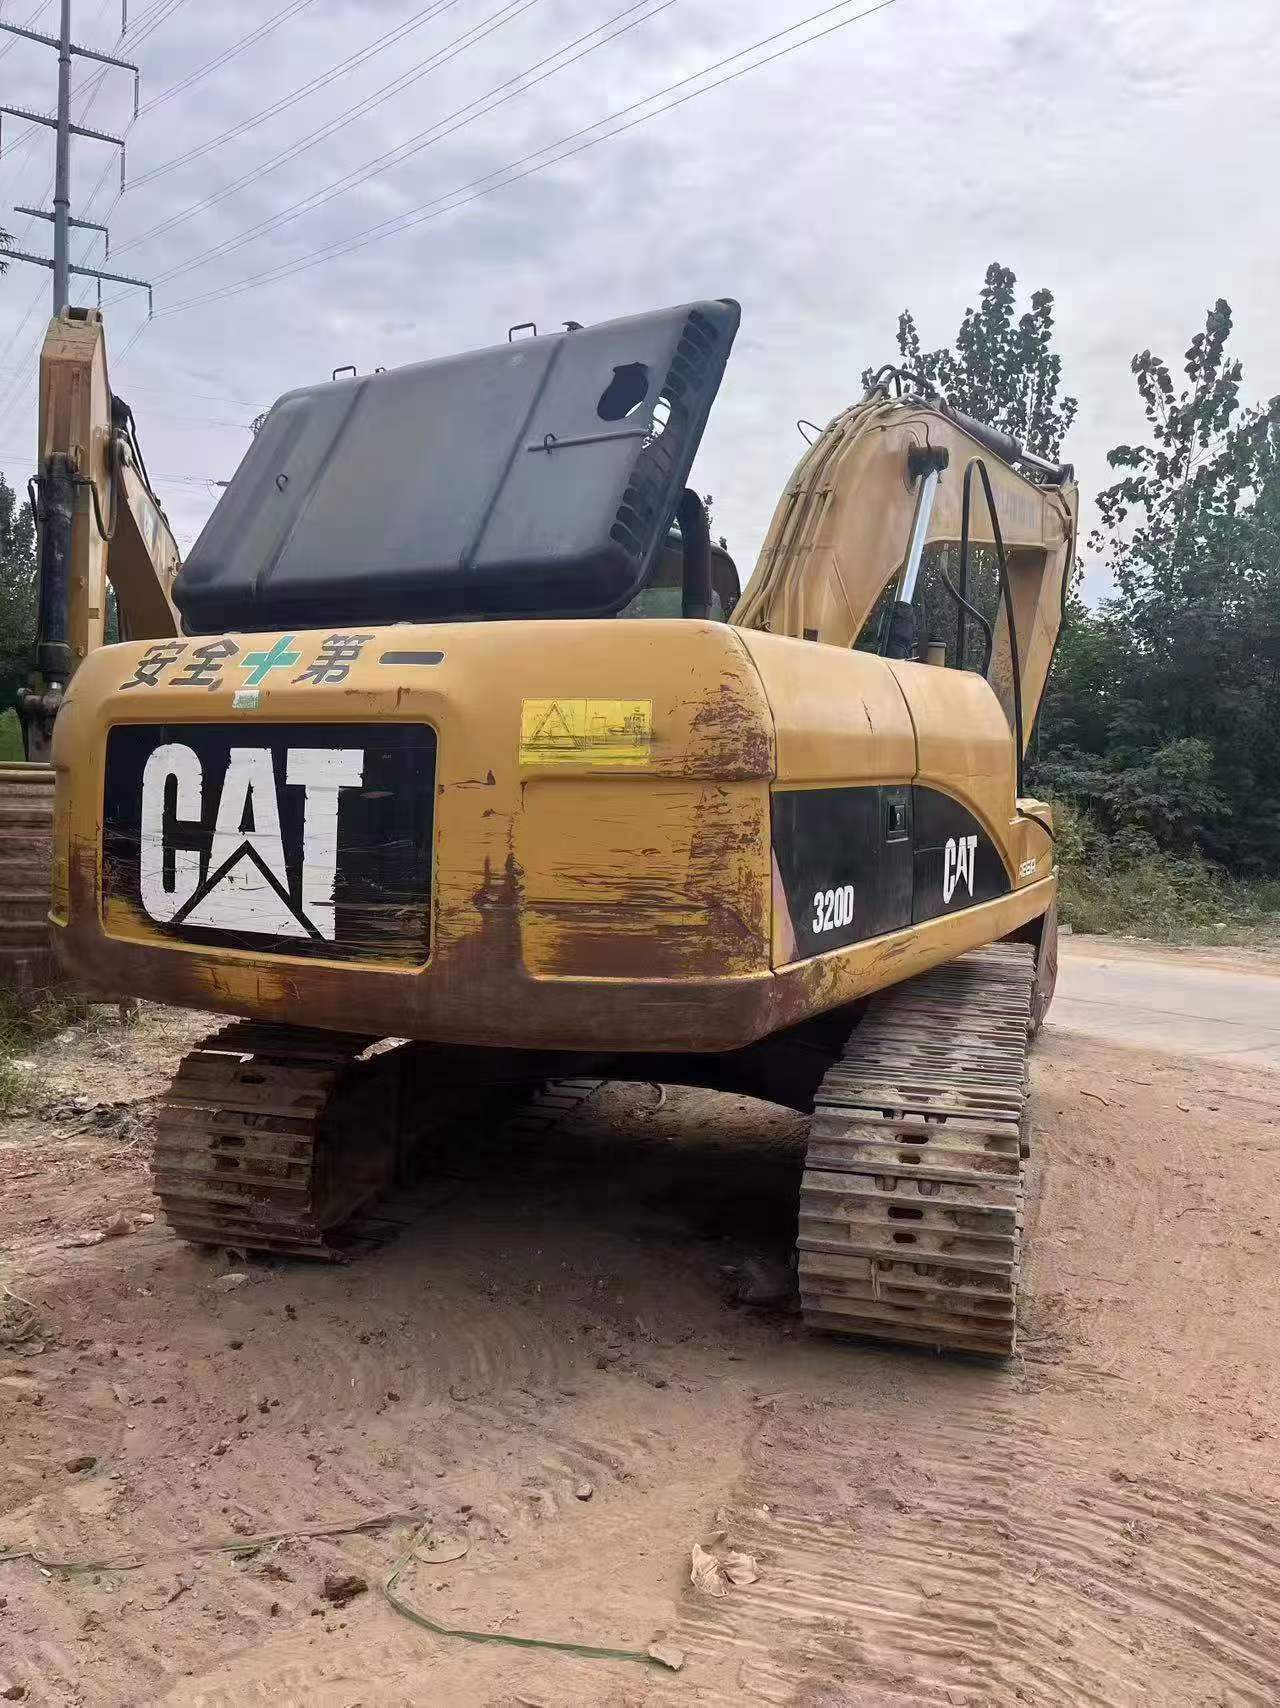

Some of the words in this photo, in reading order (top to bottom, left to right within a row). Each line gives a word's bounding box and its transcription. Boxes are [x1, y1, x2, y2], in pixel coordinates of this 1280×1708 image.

[141, 743, 364, 941] CAT
[943, 835, 978, 904] CAT
[812, 885, 855, 934] 320D
